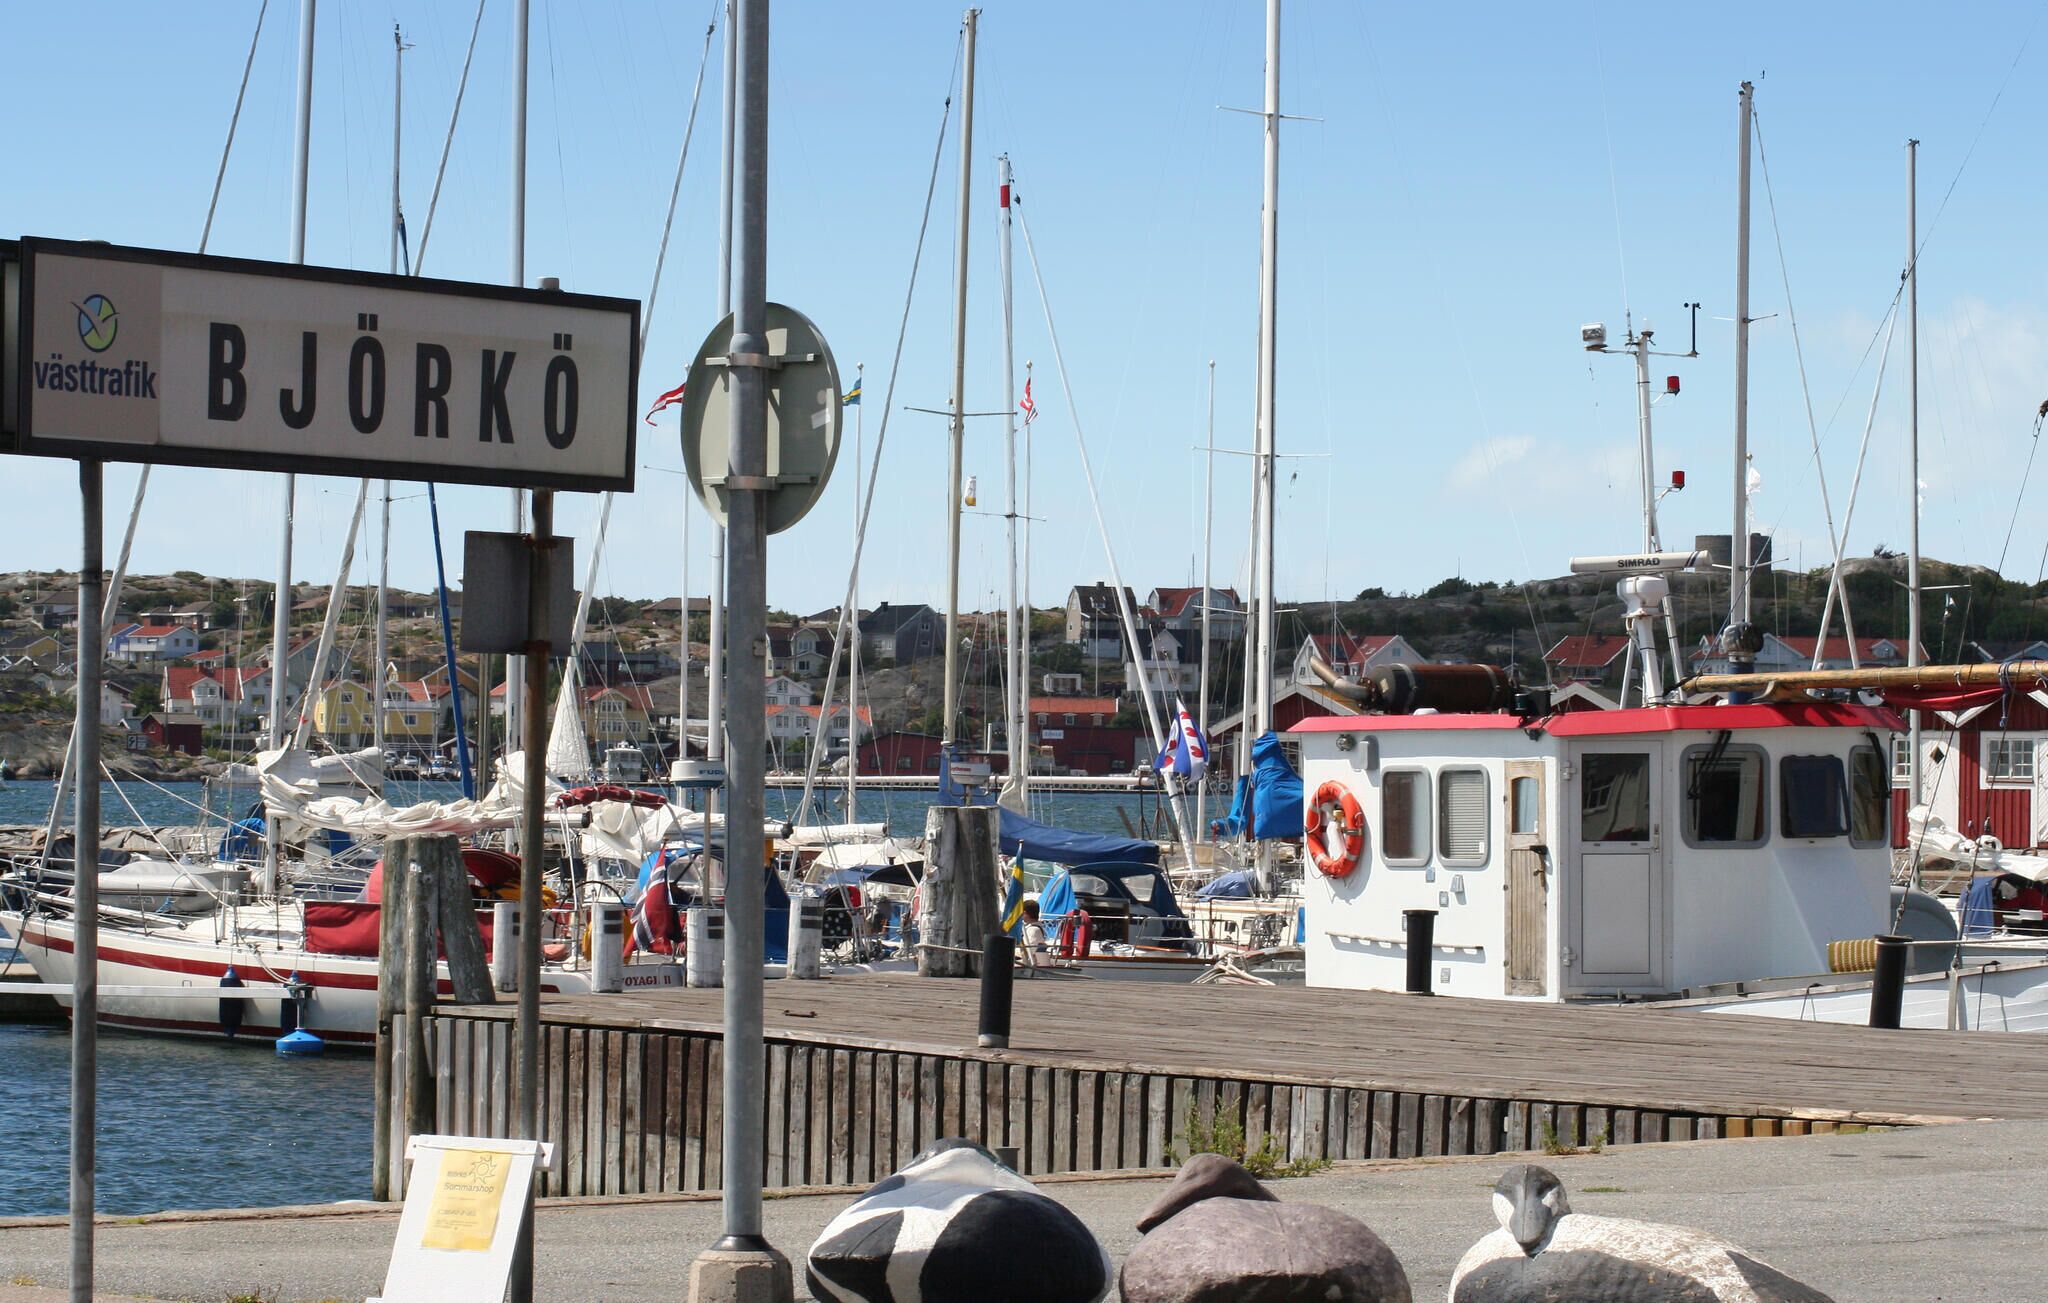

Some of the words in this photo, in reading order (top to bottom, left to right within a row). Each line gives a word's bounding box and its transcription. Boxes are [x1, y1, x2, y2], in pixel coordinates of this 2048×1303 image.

[34, 353, 157, 399] västtrafik
[207, 312, 580, 451] BJÖRKÖ
[1617, 557, 1661, 568] SIMRAD
[444, 1182, 495, 1194] Sommarshop
